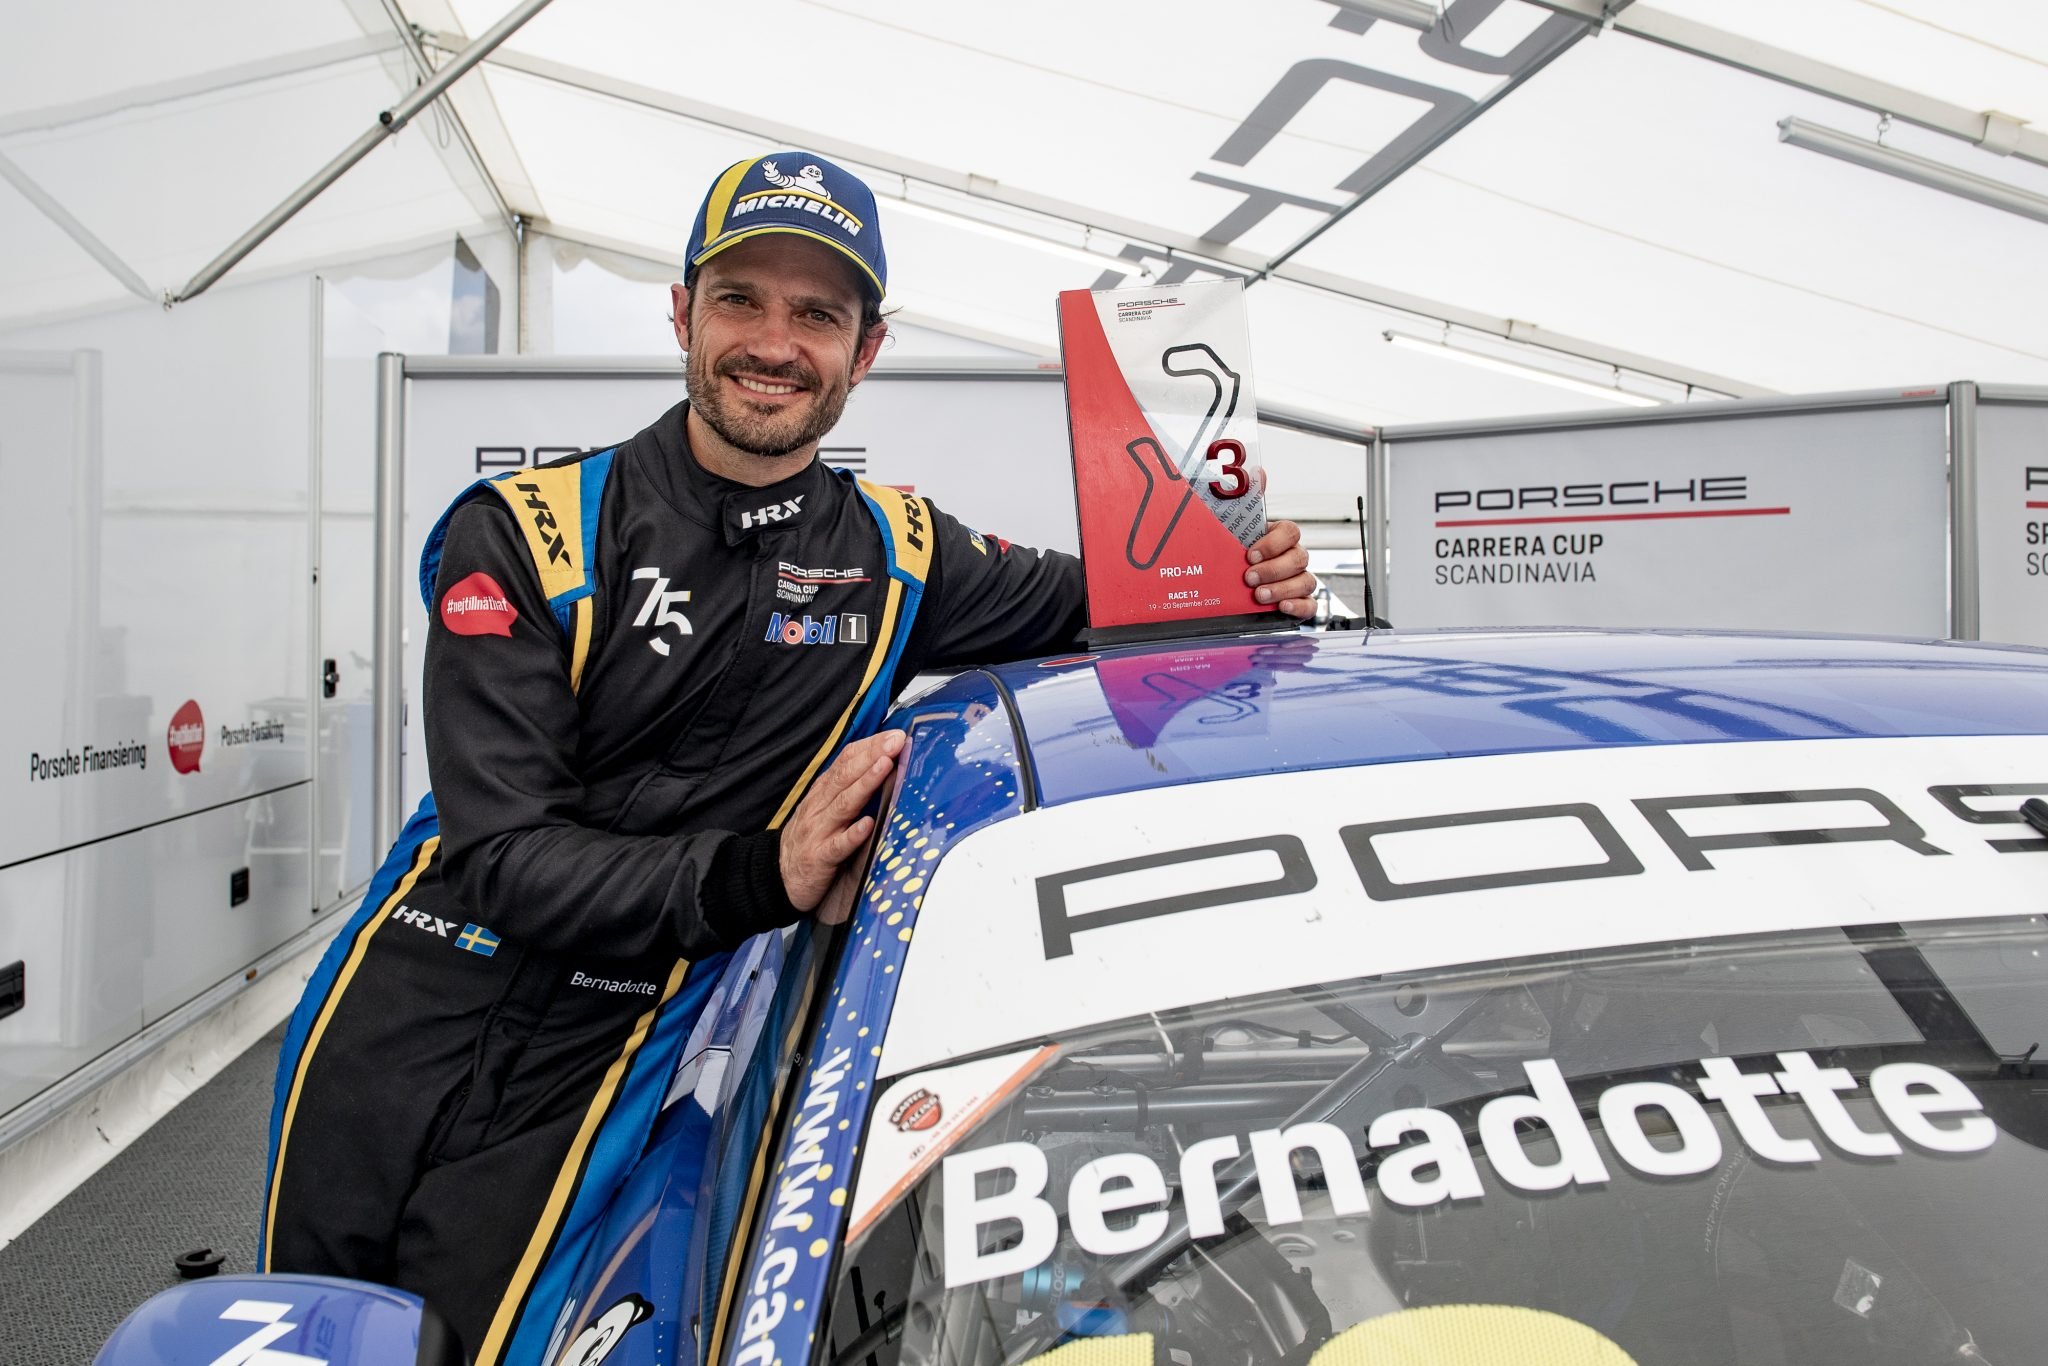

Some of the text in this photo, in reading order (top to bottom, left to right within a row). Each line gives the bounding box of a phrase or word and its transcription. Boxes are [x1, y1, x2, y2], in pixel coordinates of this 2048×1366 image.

[731, 194, 861, 237] MICHELIN
[1117, 298, 1178, 307] PORSCHE
[1206, 439, 1250, 500] 3
[1435, 476, 1747, 513] PORSCHE
[515, 484, 573, 568] HRX
[742, 494, 805, 529] HRX
[1435, 533, 1604, 559] CARRERA CUP
[778, 561, 865, 578] PORSCHE
[1160, 564, 1203, 578] PRO-AM
[1435, 561, 1597, 586] SCANDINAVIA
[803, 584, 819, 595] CUP
[1163, 602, 1171, 610] 20
[1168, 590, 1199, 600] RACE 12
[632, 567, 693, 656] 75
[765, 612, 837, 645] Mobil
[222, 723, 250, 746] Porsche
[31, 739, 147, 782] Porsche Finansiering
[1036, 783, 2048, 960] PORS
[391, 905, 458, 938] HRX
[570, 971, 656, 995] Bernadotte
[942, 1051, 1999, 1290] Bernadotte
